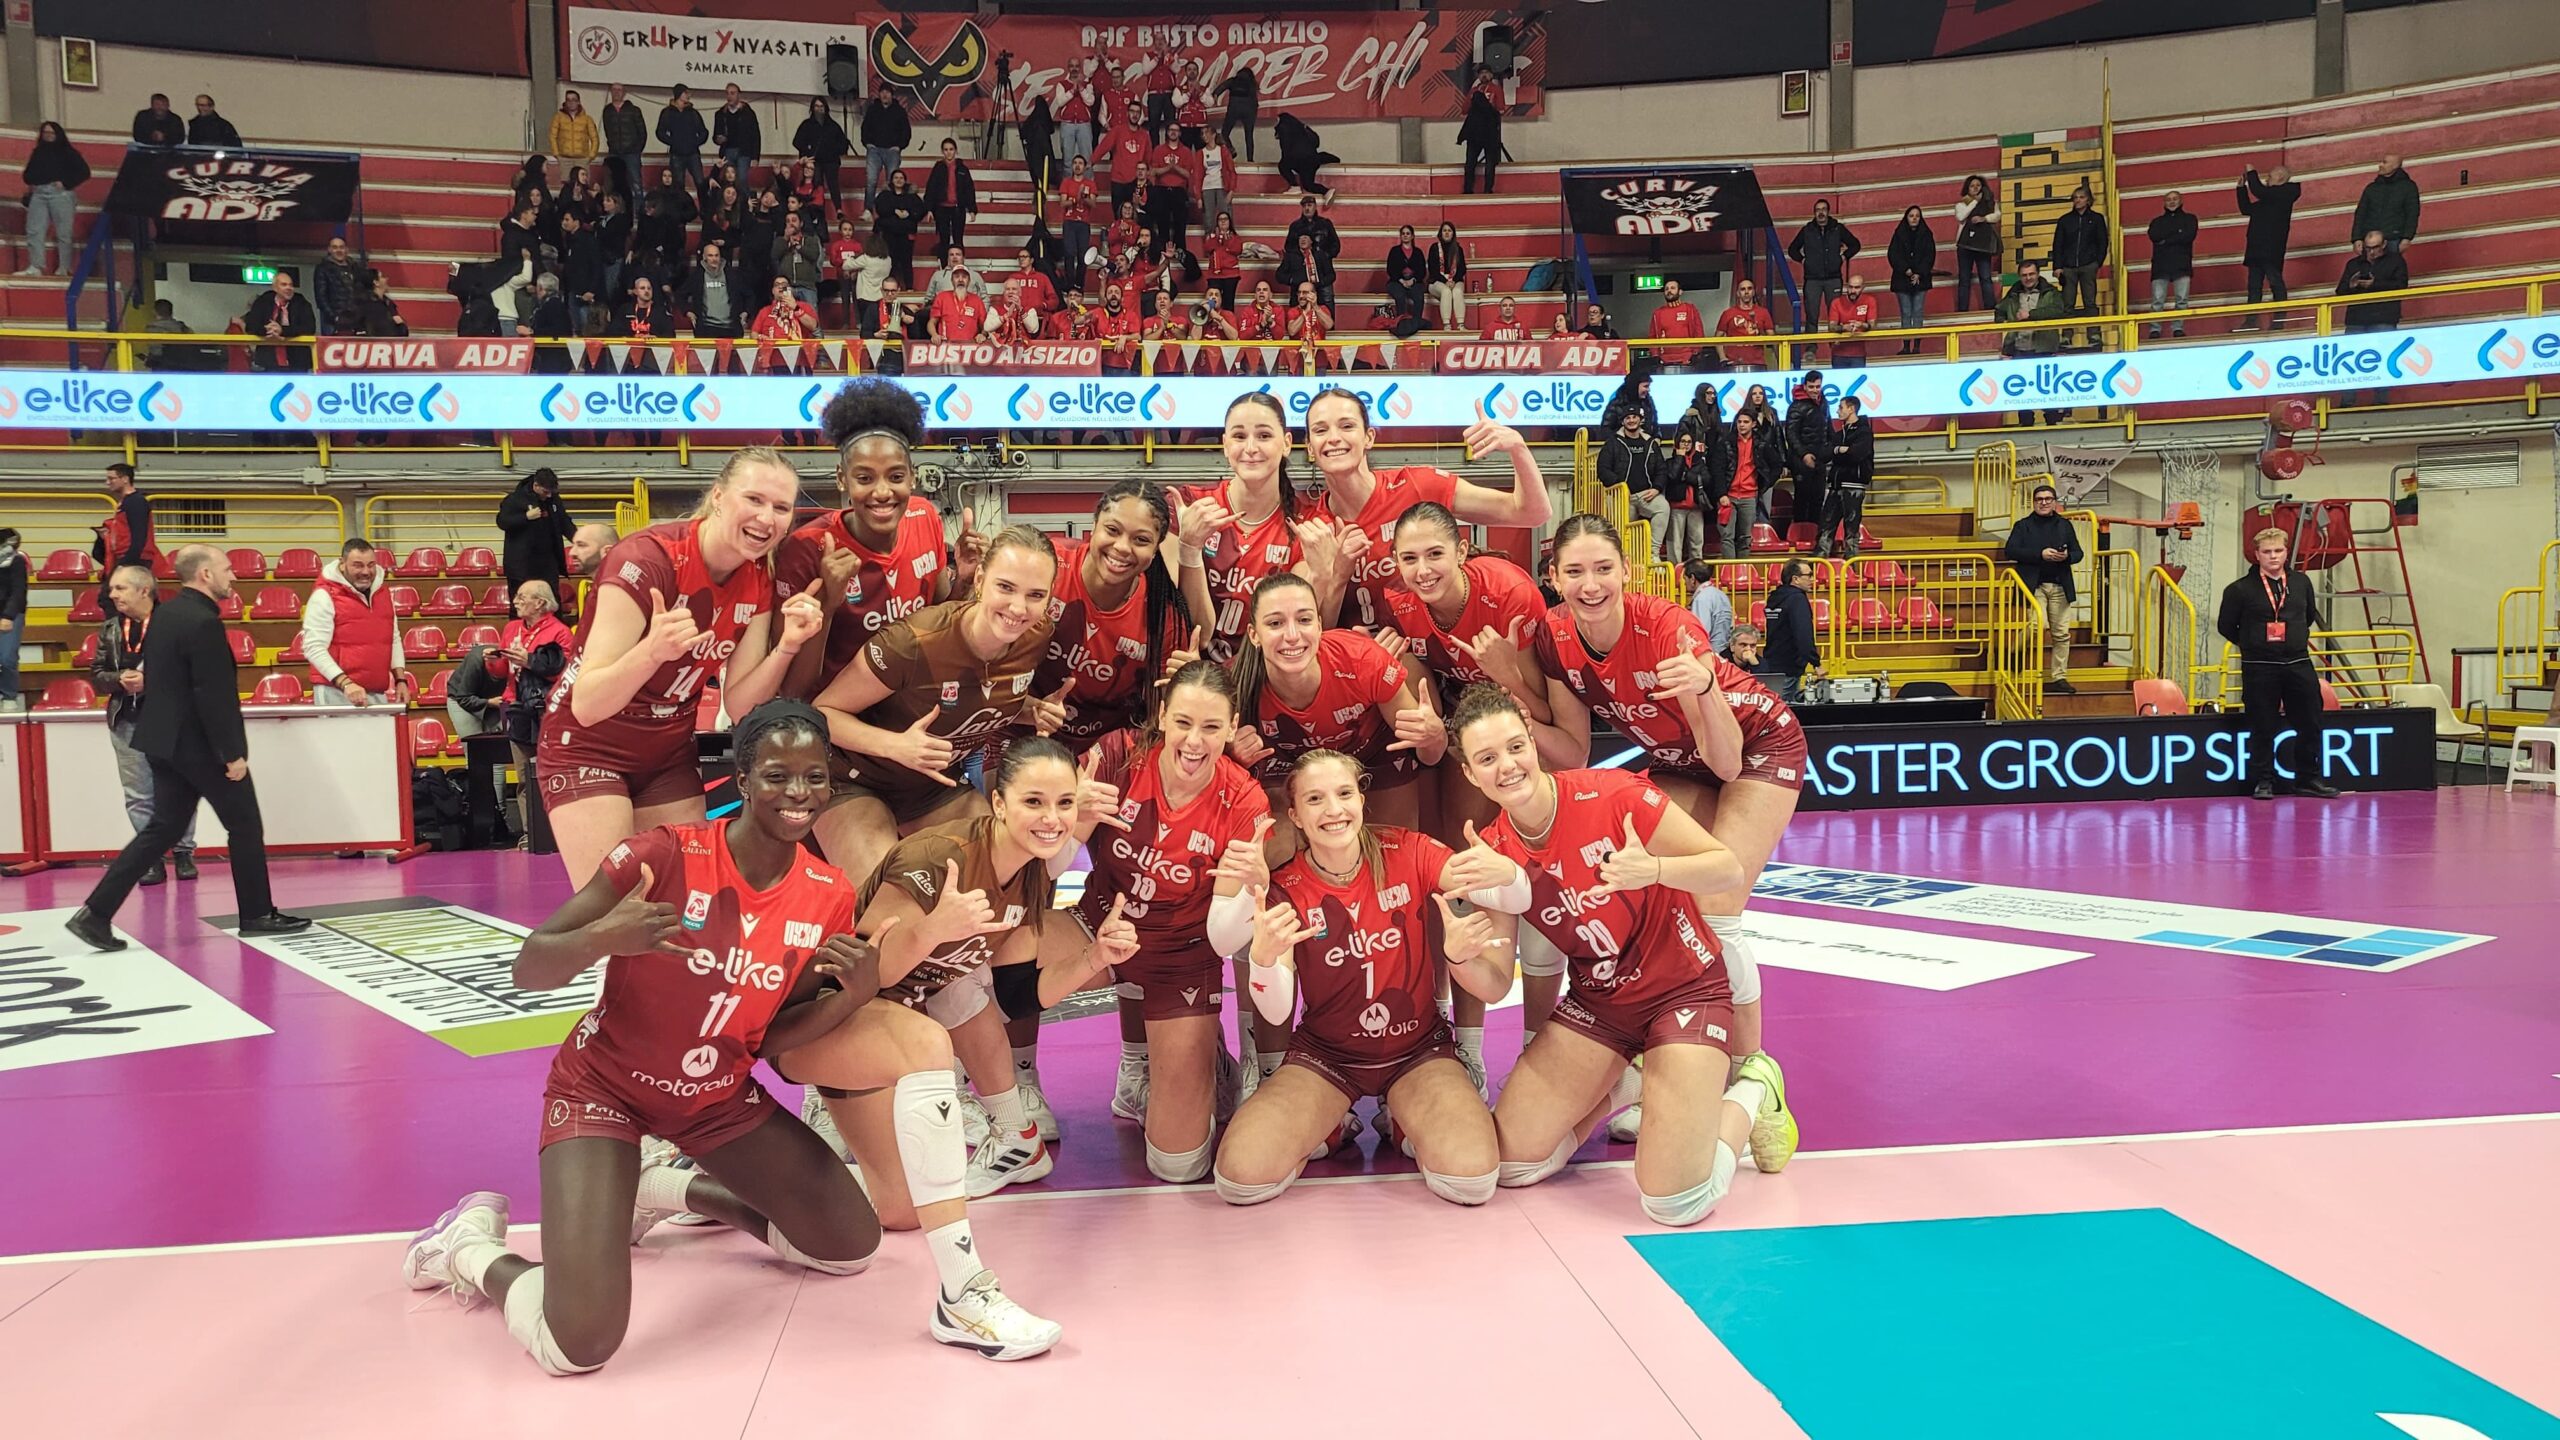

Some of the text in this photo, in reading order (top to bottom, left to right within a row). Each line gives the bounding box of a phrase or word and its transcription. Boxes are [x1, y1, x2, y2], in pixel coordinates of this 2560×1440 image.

[623, 26, 820, 57] GRUPPO YNVASATI
[1137, 23, 1220, 48] BUSTO
[1228, 20, 1329, 46] ARSIZIO
[685, 61, 754, 75] SAMARATE
[1337, 21, 1429, 107] CHI
[167, 161, 315, 186] CURVA
[1600, 178, 1720, 200] CURVA
[162, 196, 300, 221] ADF
[1616, 211, 1722, 235] ADF
[324, 343, 530, 368] CURVA ADF
[911, 345, 1096, 366] BUSTO ARSIZIO
[1445, 346, 1621, 368] CURVA ADF
[2053, 454, 2116, 467] dinospike
[1216, 598, 1245, 635] 10
[1356, 587, 1375, 625] 8
[663, 665, 705, 702] 14
[1629, 725, 1658, 746] 6
[1802, 742, 1969, 796] ASTER
[1980, 735, 2195, 790] GROUP
[1113, 838, 1192, 884] e-like
[903, 870, 937, 896] Laica
[783, 919, 824, 949] UYBA
[1325, 927, 1401, 967] e-like
[1575, 919, 1620, 958] 20
[687, 946, 785, 993] e-like
[1360, 961, 1376, 999] 1
[699, 991, 742, 1038] 11
[631, 1070, 735, 1097] motorola
